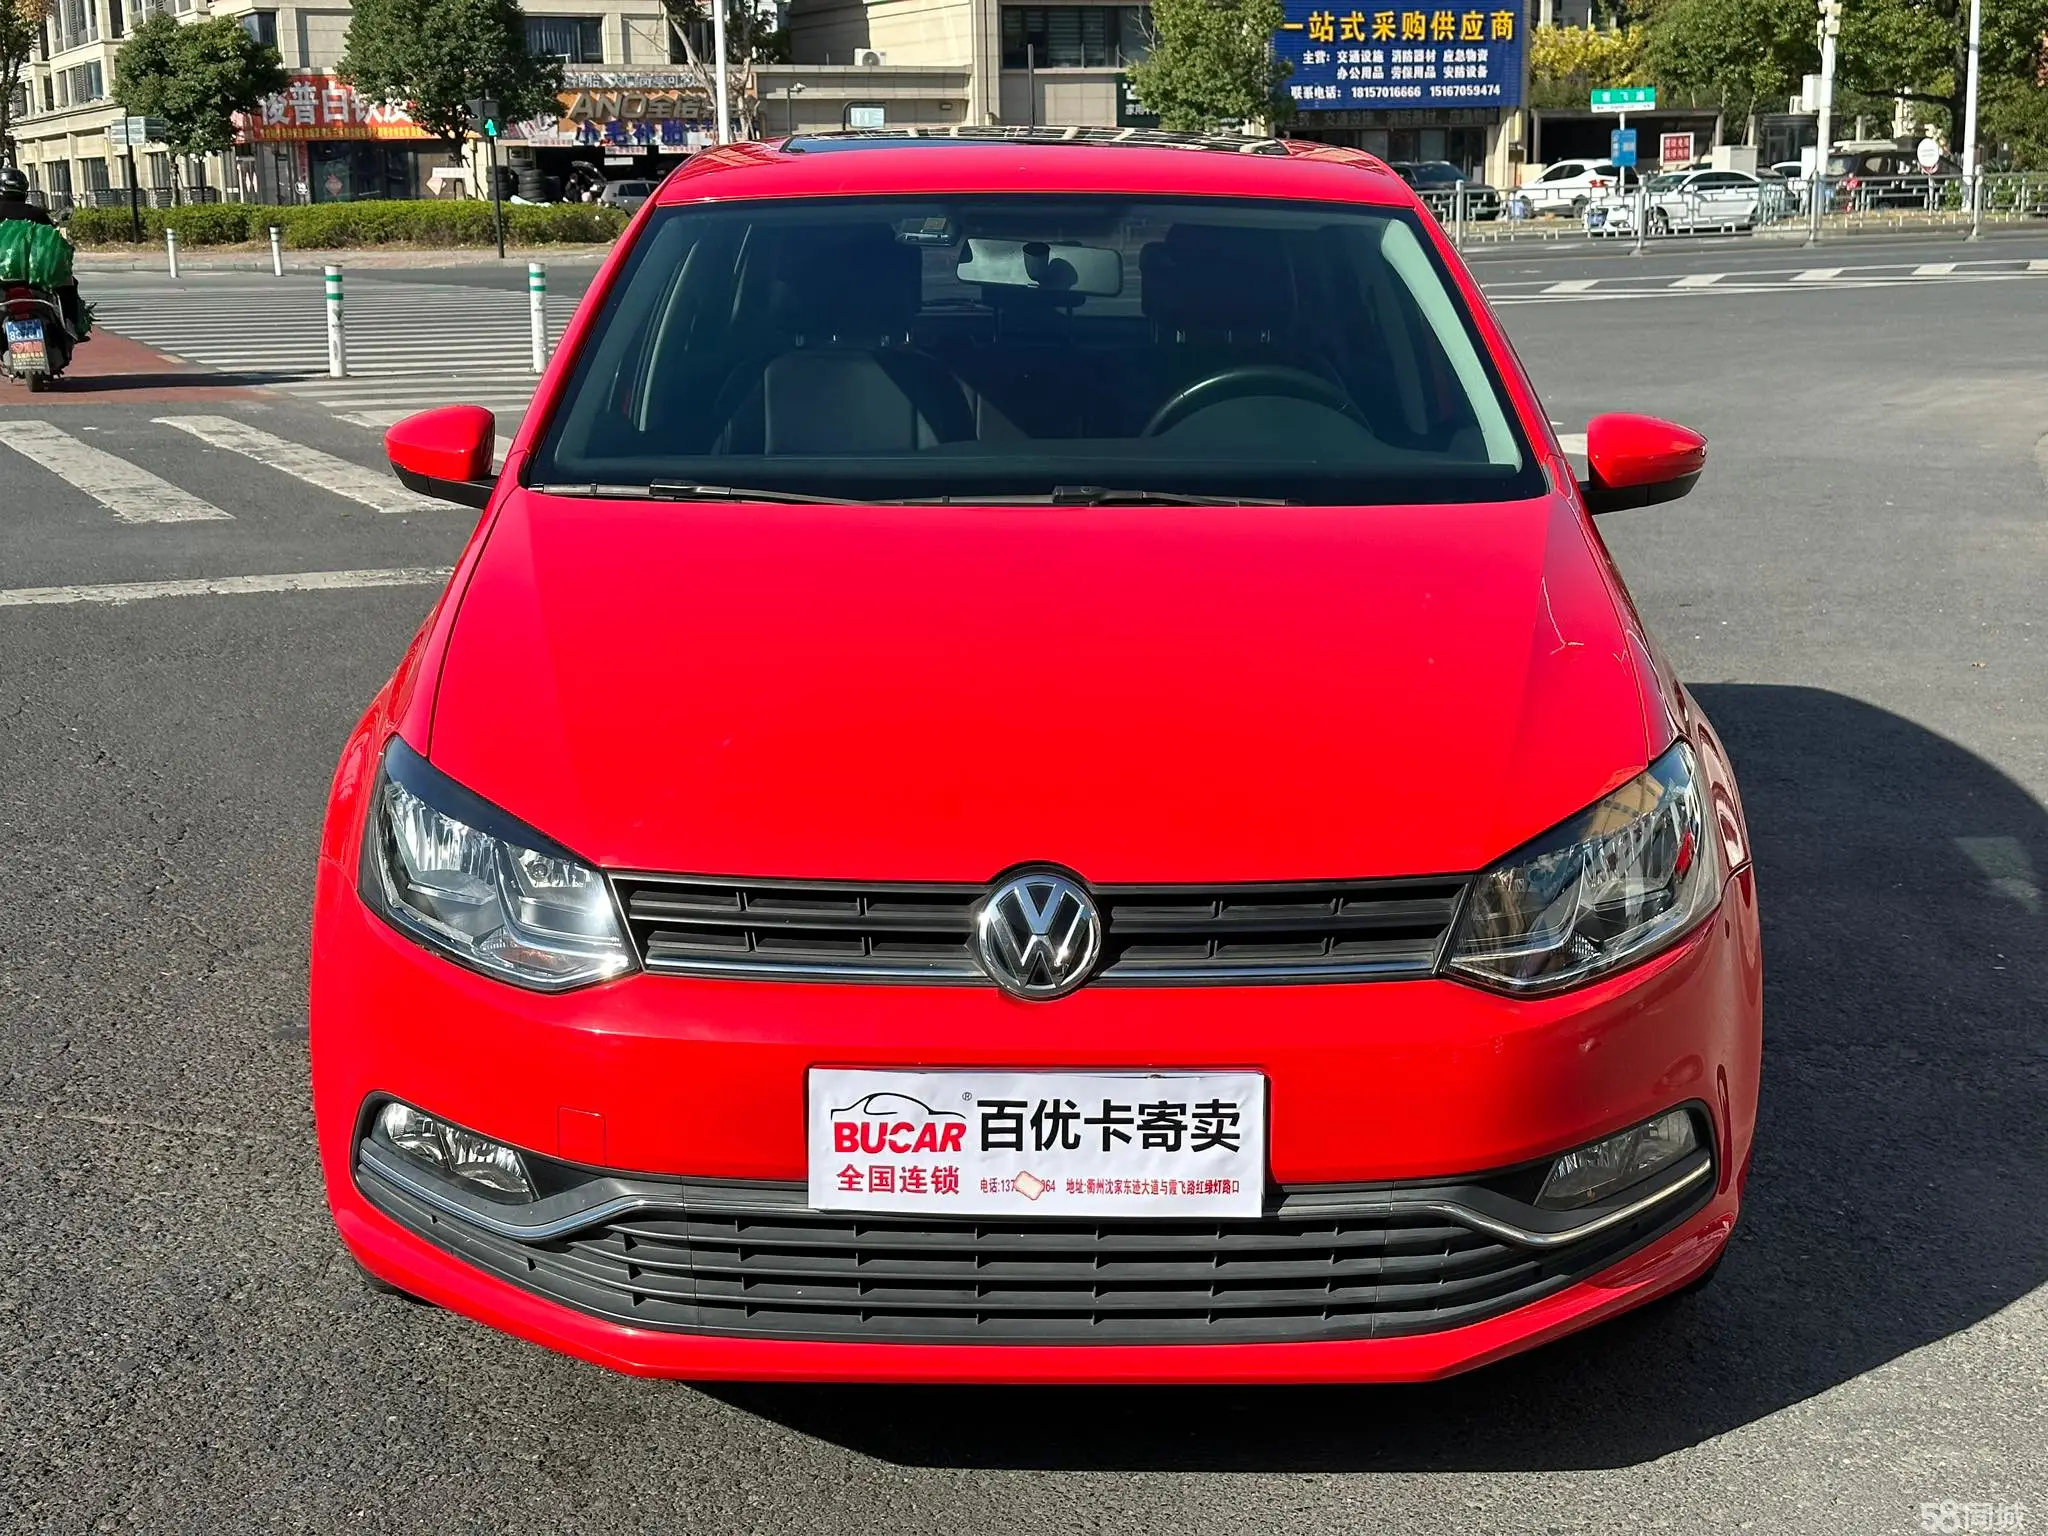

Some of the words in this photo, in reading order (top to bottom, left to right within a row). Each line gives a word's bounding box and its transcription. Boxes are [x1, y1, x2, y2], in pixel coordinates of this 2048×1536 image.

[1282, 10, 1515, 42] 一站式采购供应商
[1336, 49, 1384, 64] 交通设施
[1391, 49, 1436, 63] 消防器材
[1442, 48, 1489, 63] 应急物资
[1336, 66, 1384, 80] 办公用品
[1391, 65, 1436, 79] 劳保用品
[1442, 65, 1489, 79] 安防设备
[1351, 86, 1422, 98] 18157016666
[1429, 84, 1501, 97] 15167059474
[833, 1121, 968, 1154] BUCAR
[976, 1098, 1241, 1153] 百优卡寄卖
[836, 1163, 960, 1195] 全国连锁
